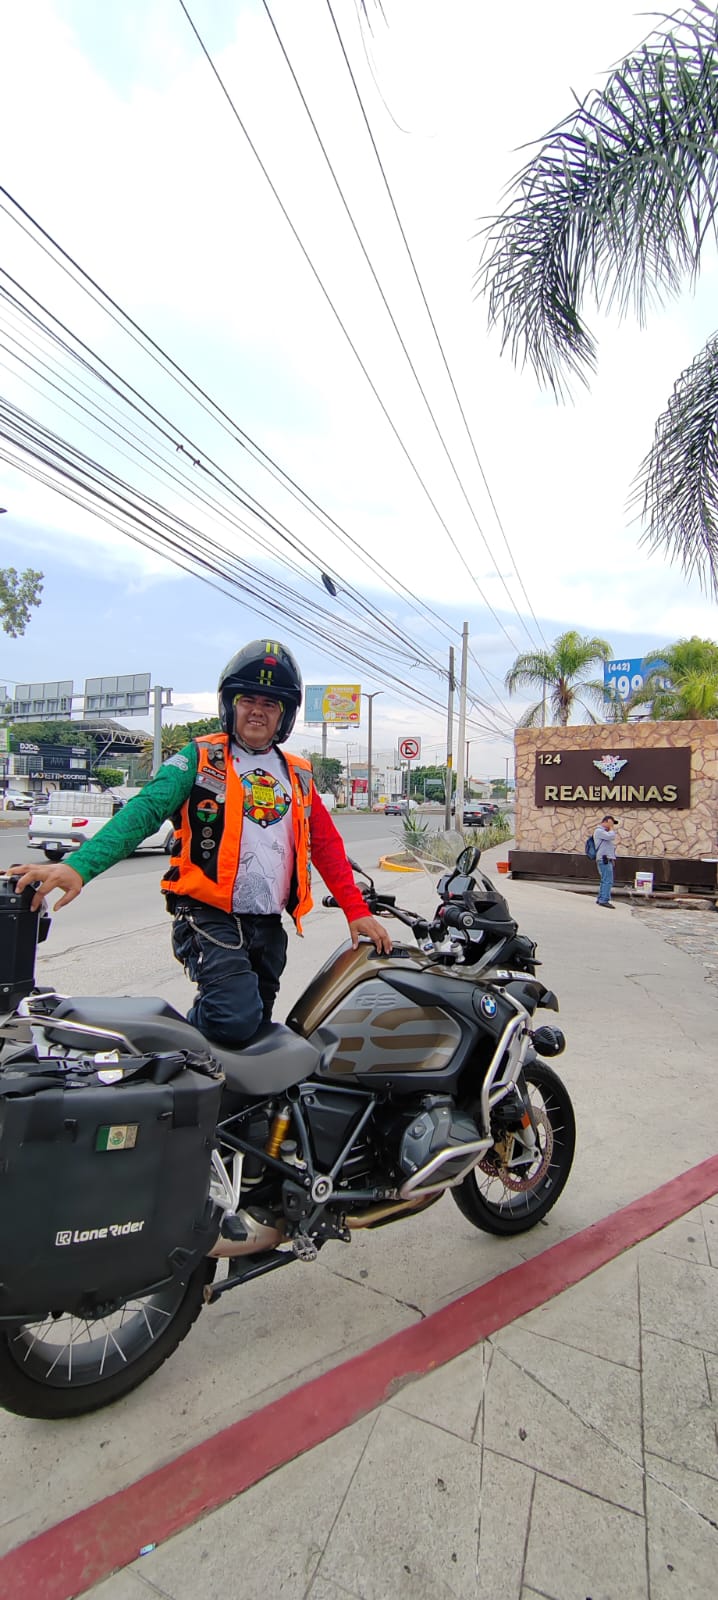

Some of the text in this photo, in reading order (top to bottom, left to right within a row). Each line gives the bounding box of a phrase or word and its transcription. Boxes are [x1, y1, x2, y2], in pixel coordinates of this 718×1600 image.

[608, 662, 631, 673] (442)
[538, 754, 562, 765] 124
[544, 785, 598, 801] REAL
[601, 784, 678, 802] MINAS
[73, 1228, 108, 1243] Lone
[109, 1220, 145, 1237] Rider
